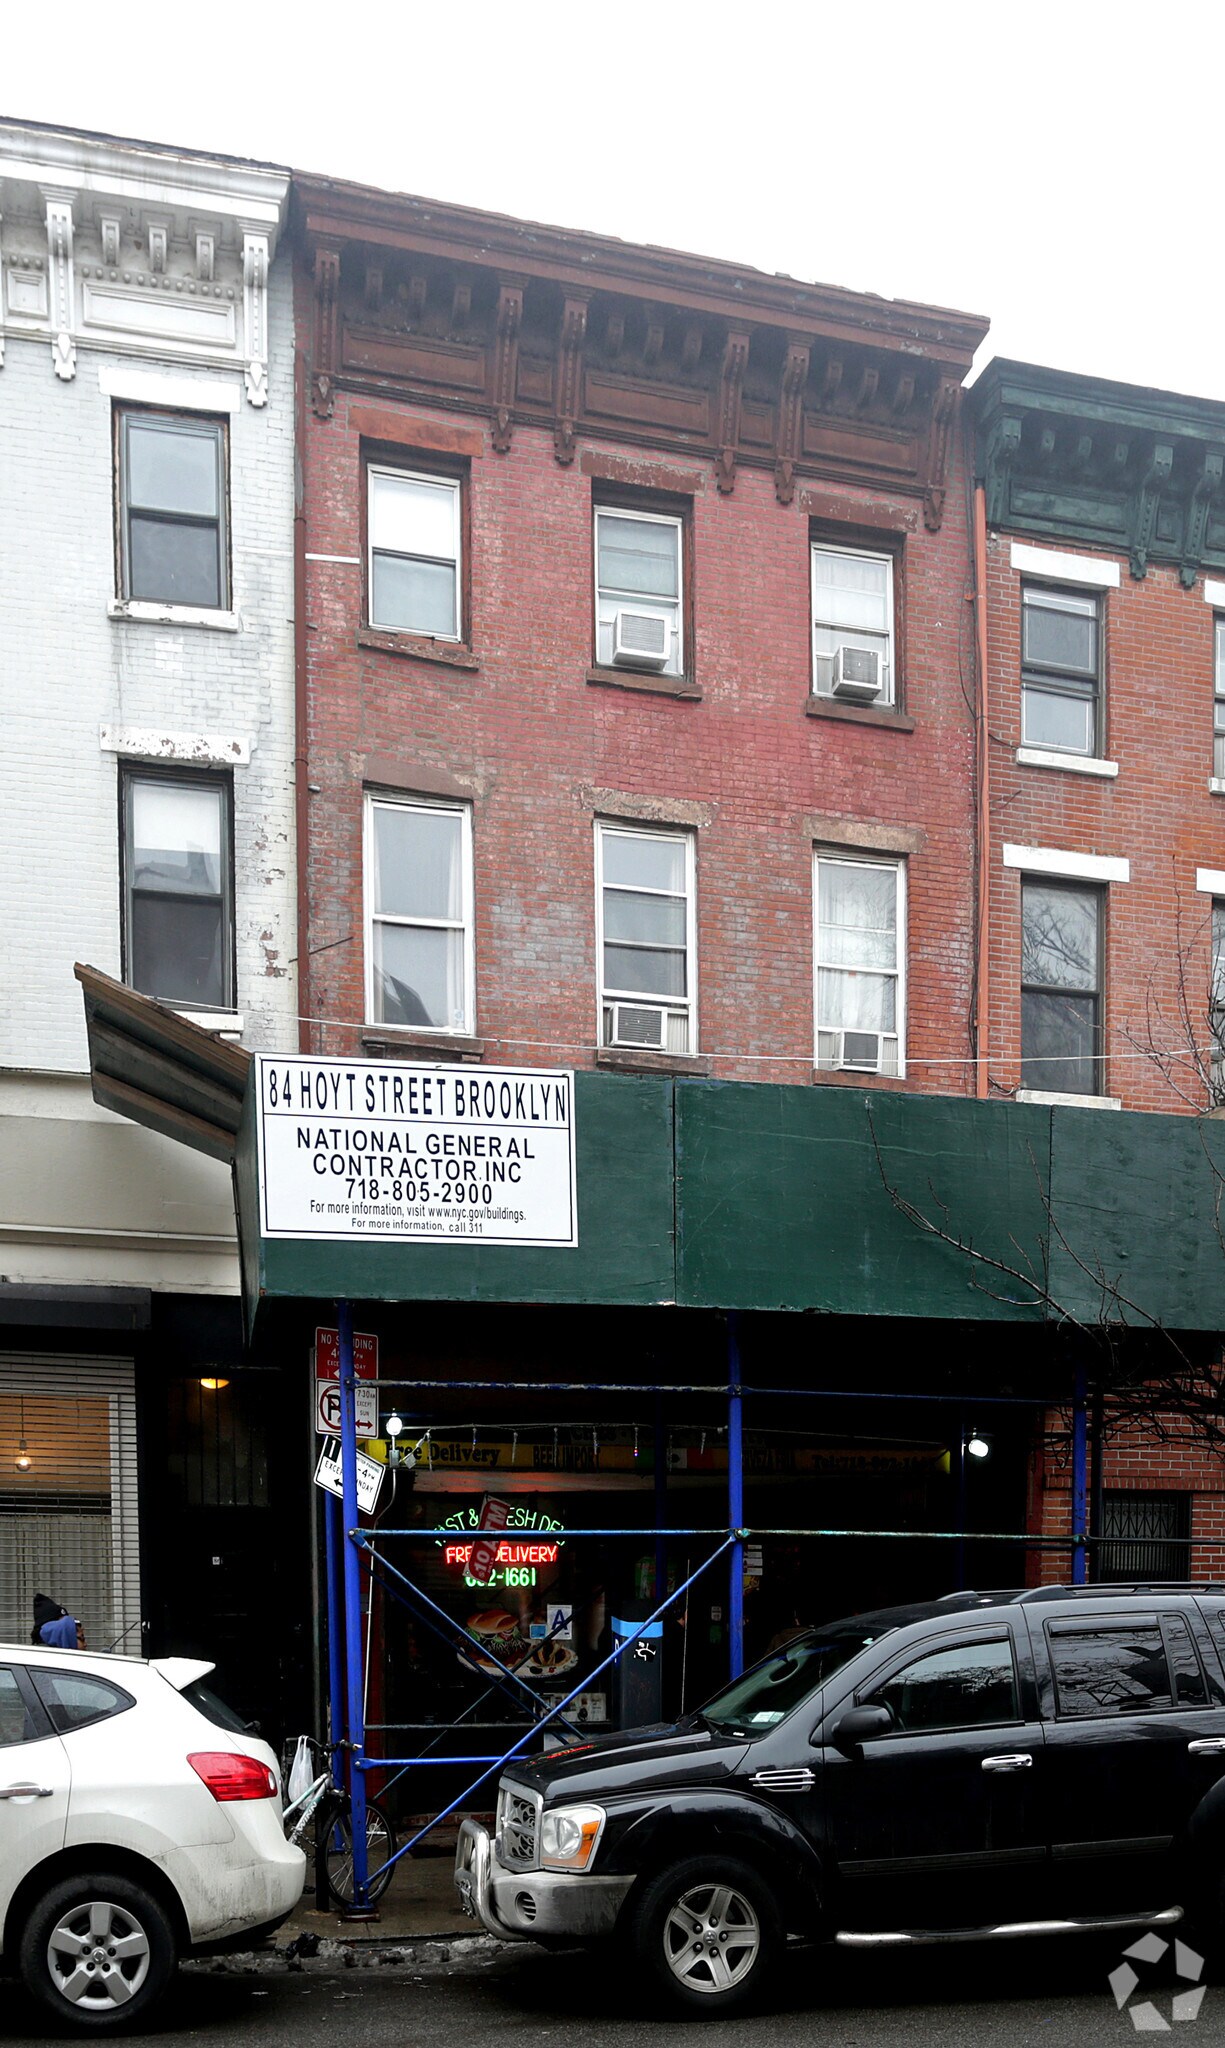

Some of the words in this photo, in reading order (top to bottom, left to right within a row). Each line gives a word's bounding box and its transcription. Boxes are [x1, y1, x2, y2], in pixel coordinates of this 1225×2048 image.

[269, 1069, 292, 1108] 84
[300, 1070, 356, 1111] HOYT
[365, 1073, 447, 1116] STREET
[454, 1078, 566, 1122] BROOKLYN
[297, 1127, 418, 1154] NATIONAL
[425, 1133, 536, 1159] GENERAL
[345, 1177, 492, 1205] 718-805-2900
[310, 1199, 325, 1213] For
[327, 1203, 350, 1214] more
[352, 1201, 405, 1217] information,
[407, 1205, 426, 1217] visit
[428, 1206, 526, 1223] www.nyc.gov/buildings.
[351, 1217, 365, 1227] For
[368, 1220, 391, 1229] more
[448, 1223, 466, 1233] call
[469, 1223, 483, 1233] 311
[320, 1333, 332, 1345] NO
[336, 1335, 373, 1350] SDING
[328, 1439, 336, 1458] 1
[384, 1441, 423, 1460] Free
[427, 1443, 501, 1468] Delivery
[357, 1479, 374, 1493] NDAY
[468, 1508, 479, 1527] &
[507, 1506, 538, 1530] ESH
[445, 1545, 473, 1564] FRE
[551, 1608, 568, 1631] A
